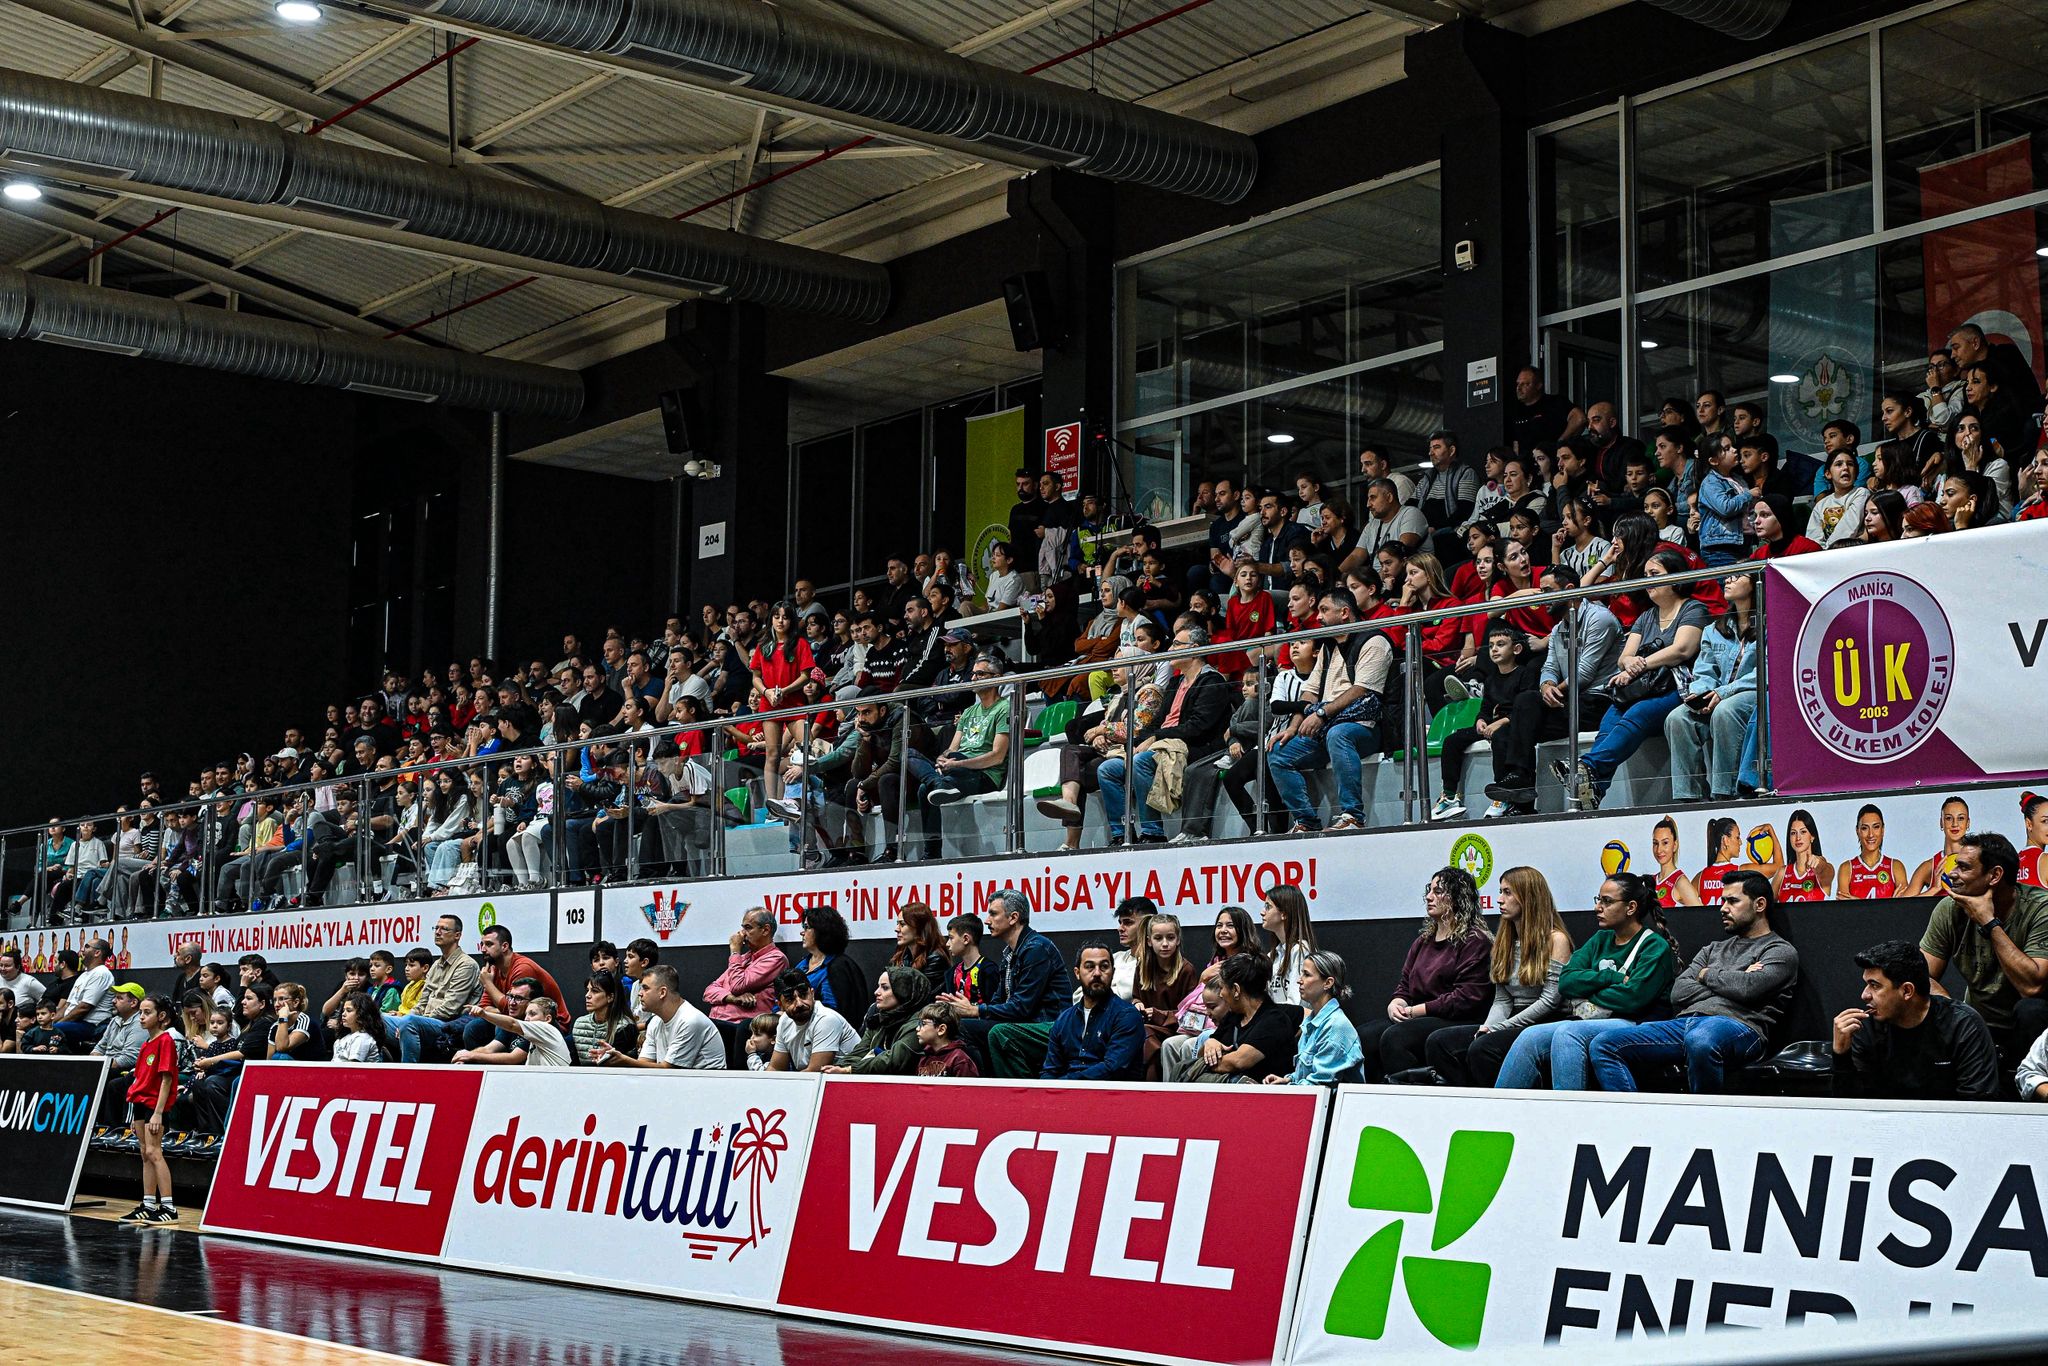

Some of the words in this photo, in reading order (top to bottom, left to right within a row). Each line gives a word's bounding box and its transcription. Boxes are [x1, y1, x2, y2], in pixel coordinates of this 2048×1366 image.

[705, 533, 719, 546] 204
[1848, 578, 1893, 602] MANİSA
[1801, 668, 1822, 728] ÖZEL
[1828, 724, 1903, 753] ÜLKEM
[1905, 655, 1948, 739] KOLEJİ
[1859, 705, 1889, 719] 2003
[888, 872, 963, 920] KALBİ
[973, 866, 1165, 916] MNİSA'YLA
[1175, 858, 1318, 906] ATIYOR!
[228, 919, 264, 952] KALBİ
[268, 917, 354, 950] MANİSA'YLA
[358, 915, 421, 946] ATIYOR!
[566, 908, 585, 925] 103
[0, 1089, 89, 1135] UMGYM
[244, 1094, 436, 1206] VESTEL
[848, 1122, 1235, 1291] VESTEL
